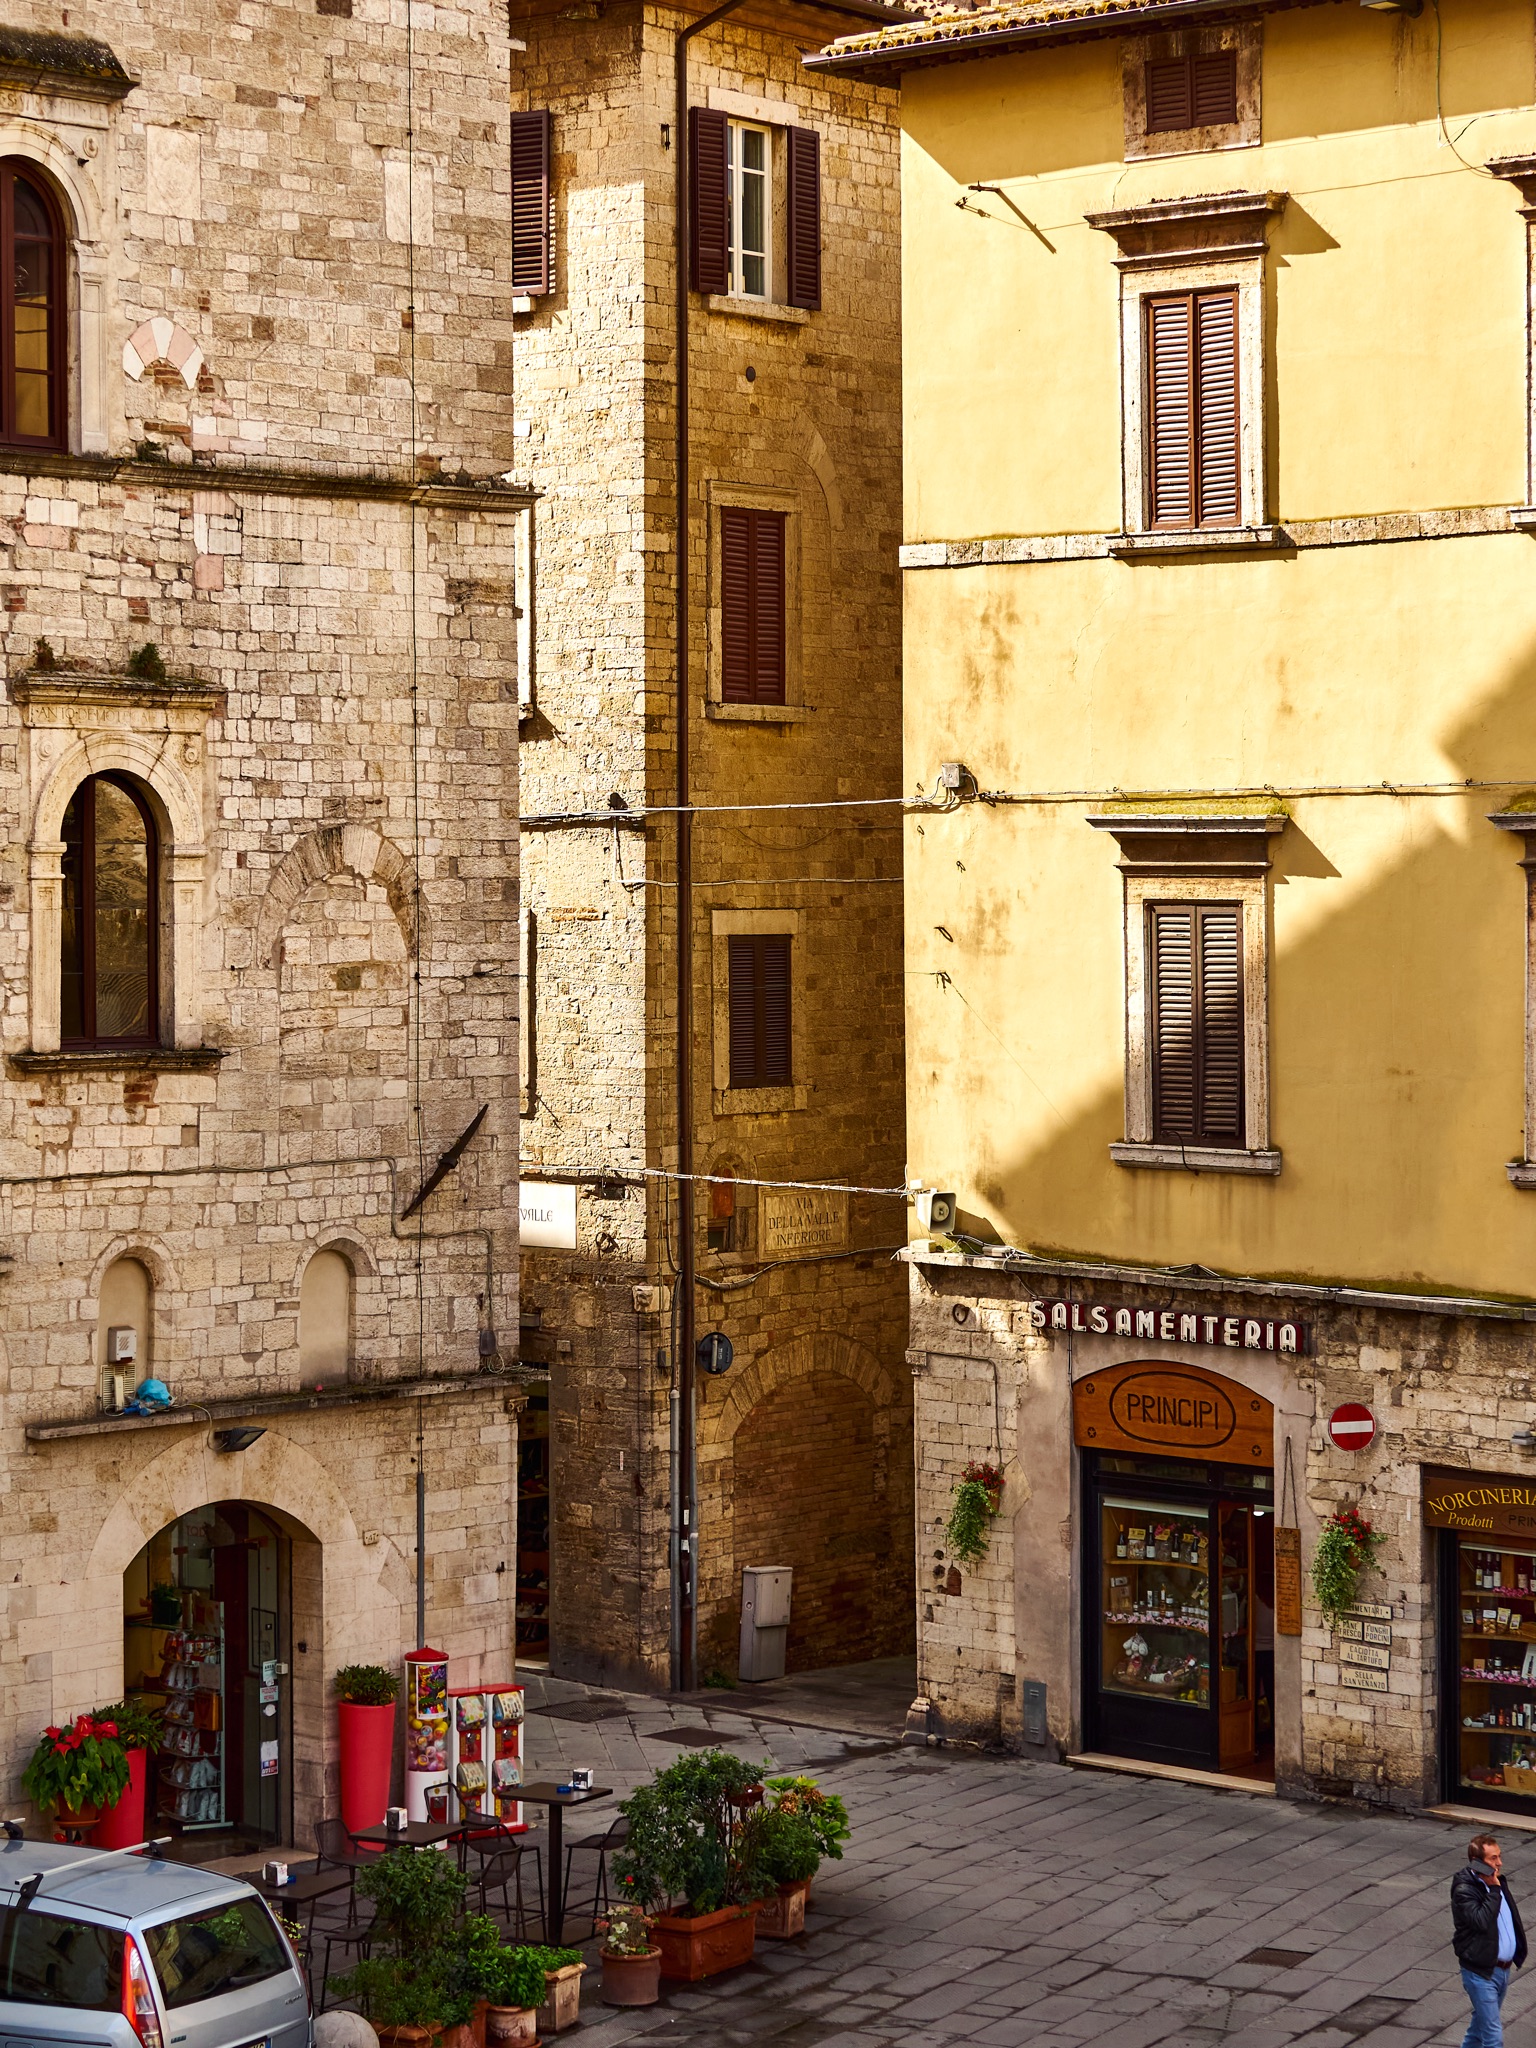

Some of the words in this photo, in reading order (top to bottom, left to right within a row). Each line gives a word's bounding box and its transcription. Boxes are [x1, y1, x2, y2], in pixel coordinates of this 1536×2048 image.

[796, 1197, 813, 1209] VIA
[769, 1215, 803, 1230] DELLA
[806, 1211, 840, 1226] VALLE
[776, 1229, 832, 1246] INFERIORE
[1030, 1300, 1302, 1353] SALSAMENTERIA
[1126, 1393, 1219, 1430] PRINCIPI
[1447, 1511, 1494, 1529] Prodotti
[1342, 1620, 1358, 1631] PANE
[1366, 1624, 1389, 1636] FUNGHI
[1339, 1628, 1362, 1639] FRESCO
[1365, 1632, 1390, 1645] PORCINI
[1349, 1645, 1379, 1658] CACIOTTA
[1346, 1652, 1354, 1660] AL
[1356, 1654, 1383, 1666] TARTUFO
[1354, 1671, 1374, 1680] SELLA
[1343, 1676, 1357, 1686] SAN
[1357, 1677, 1386, 1690] VENANZO
